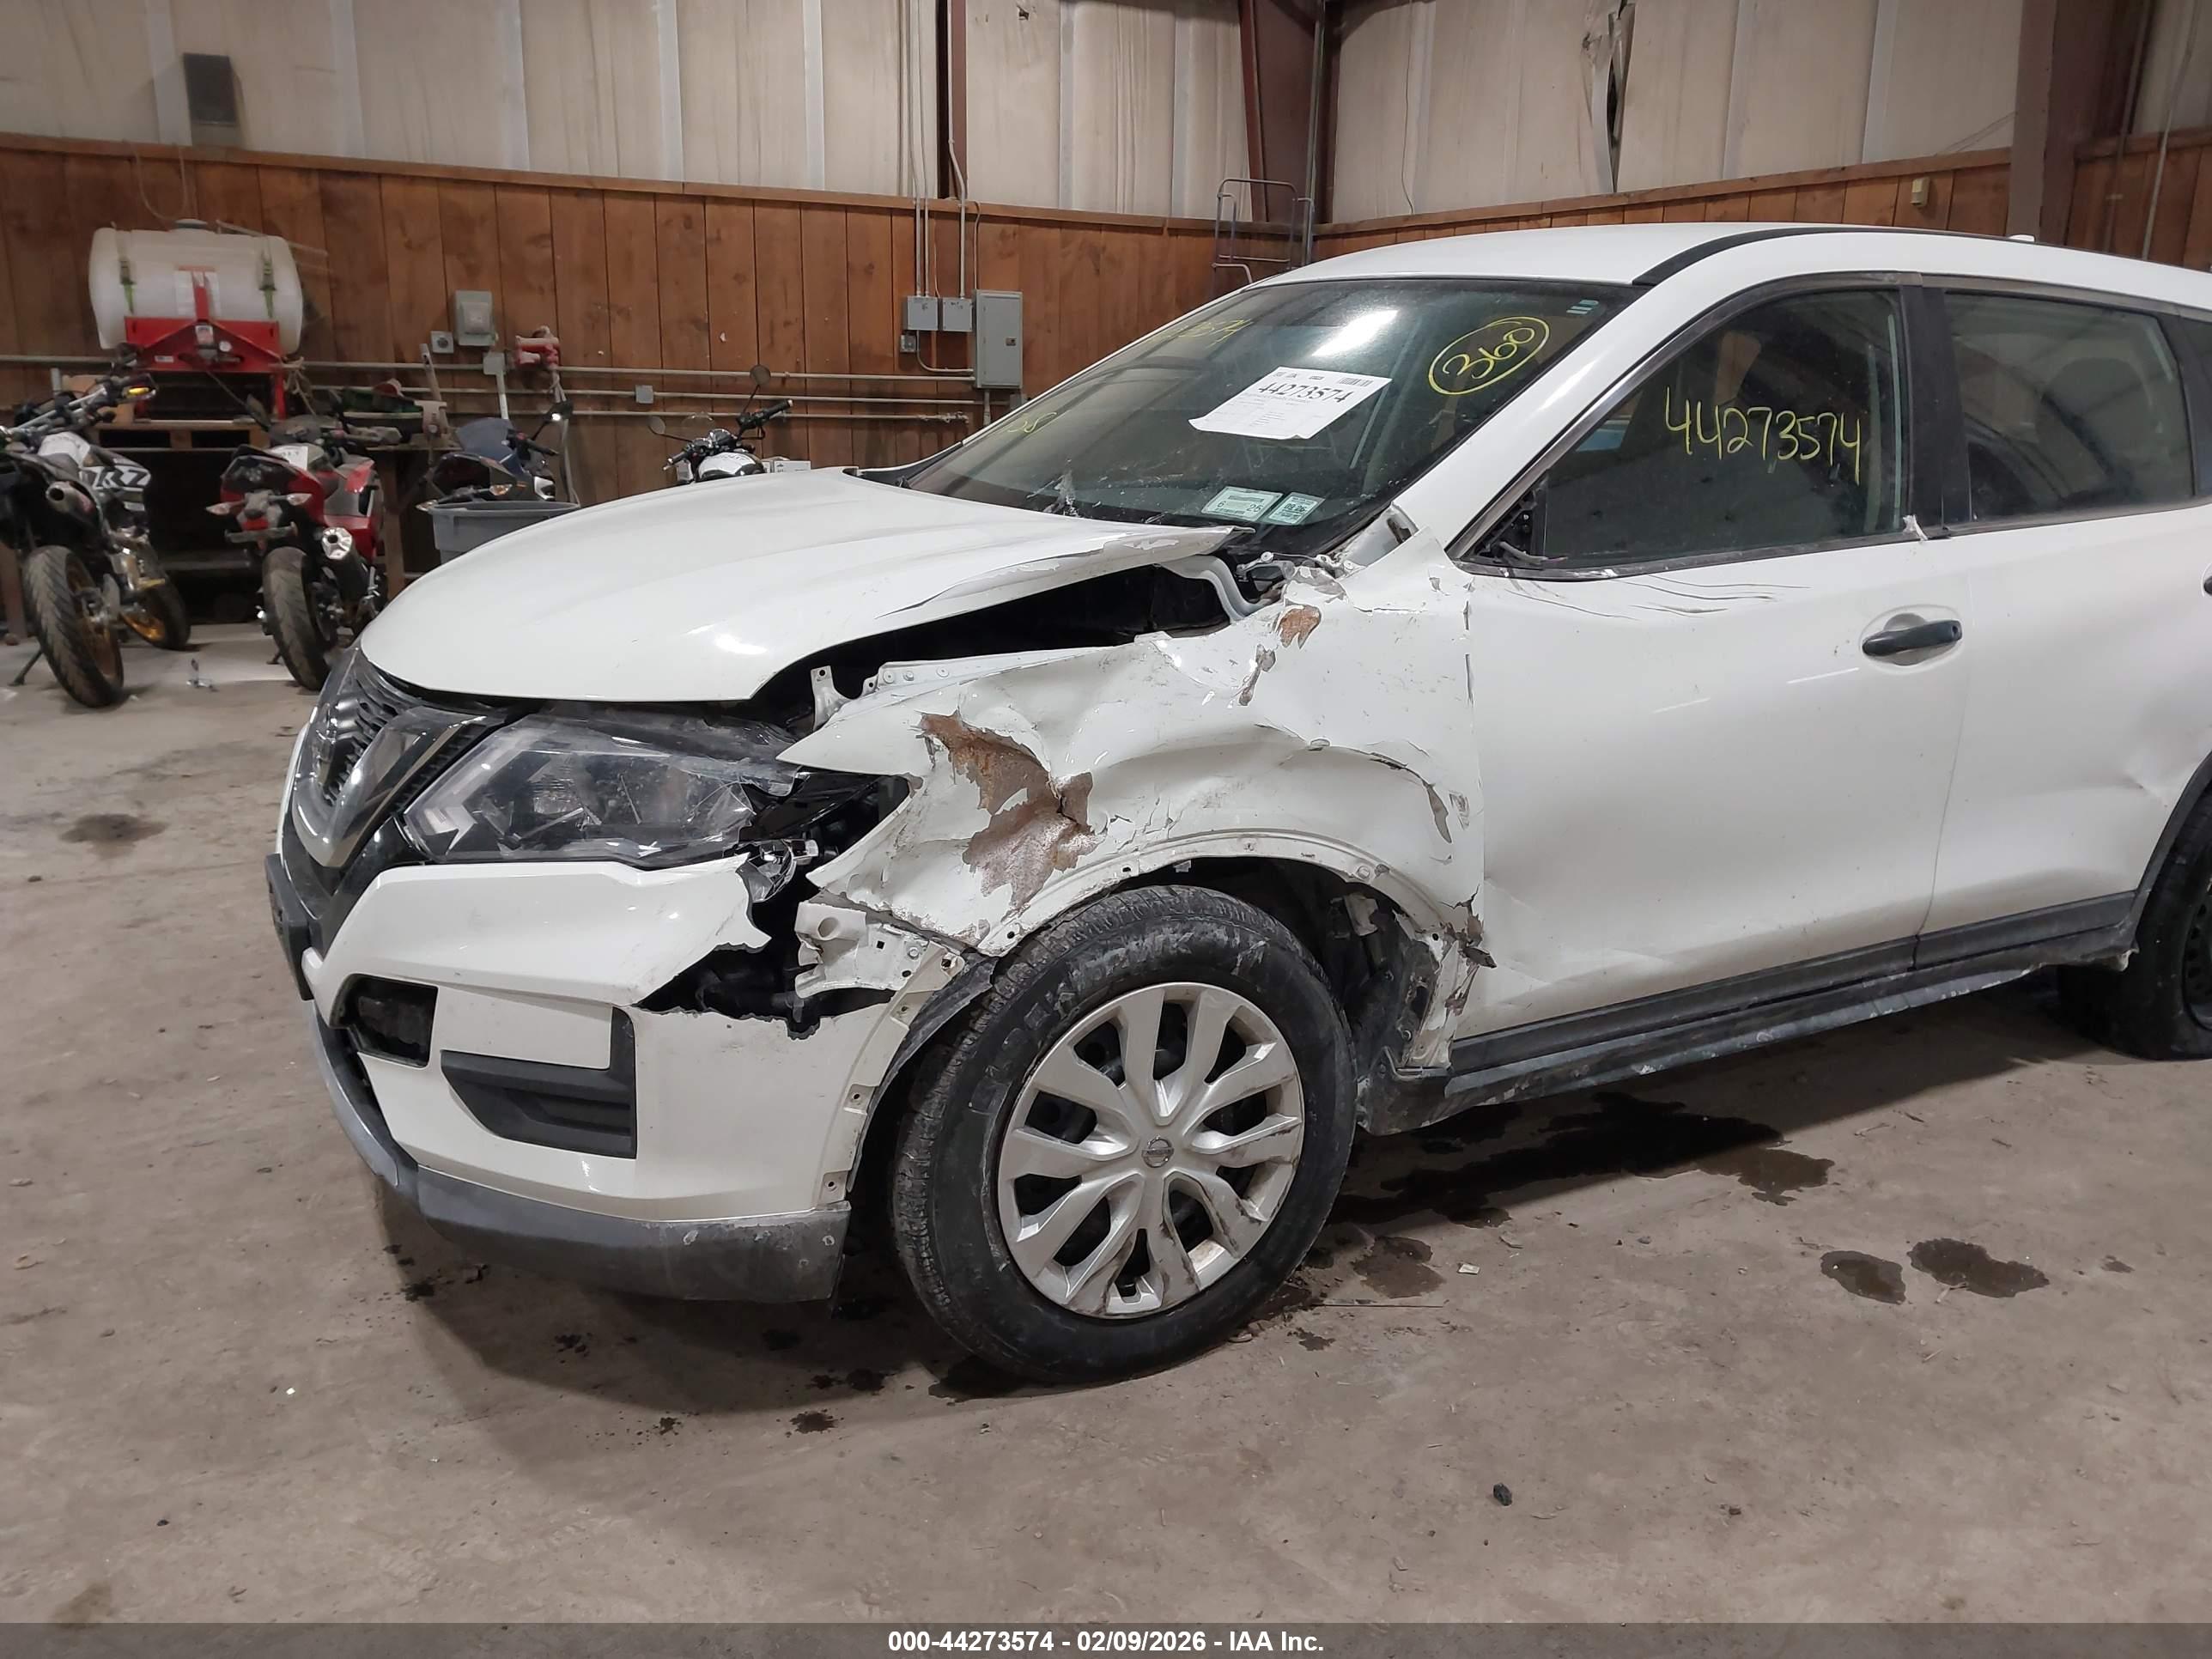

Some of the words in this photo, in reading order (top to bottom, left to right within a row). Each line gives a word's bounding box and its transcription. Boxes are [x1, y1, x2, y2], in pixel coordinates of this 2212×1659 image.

[1442, 327, 1535, 380] 360
[1258, 381, 1355, 403] 44273574
[1665, 386, 1861, 487] 44273574
